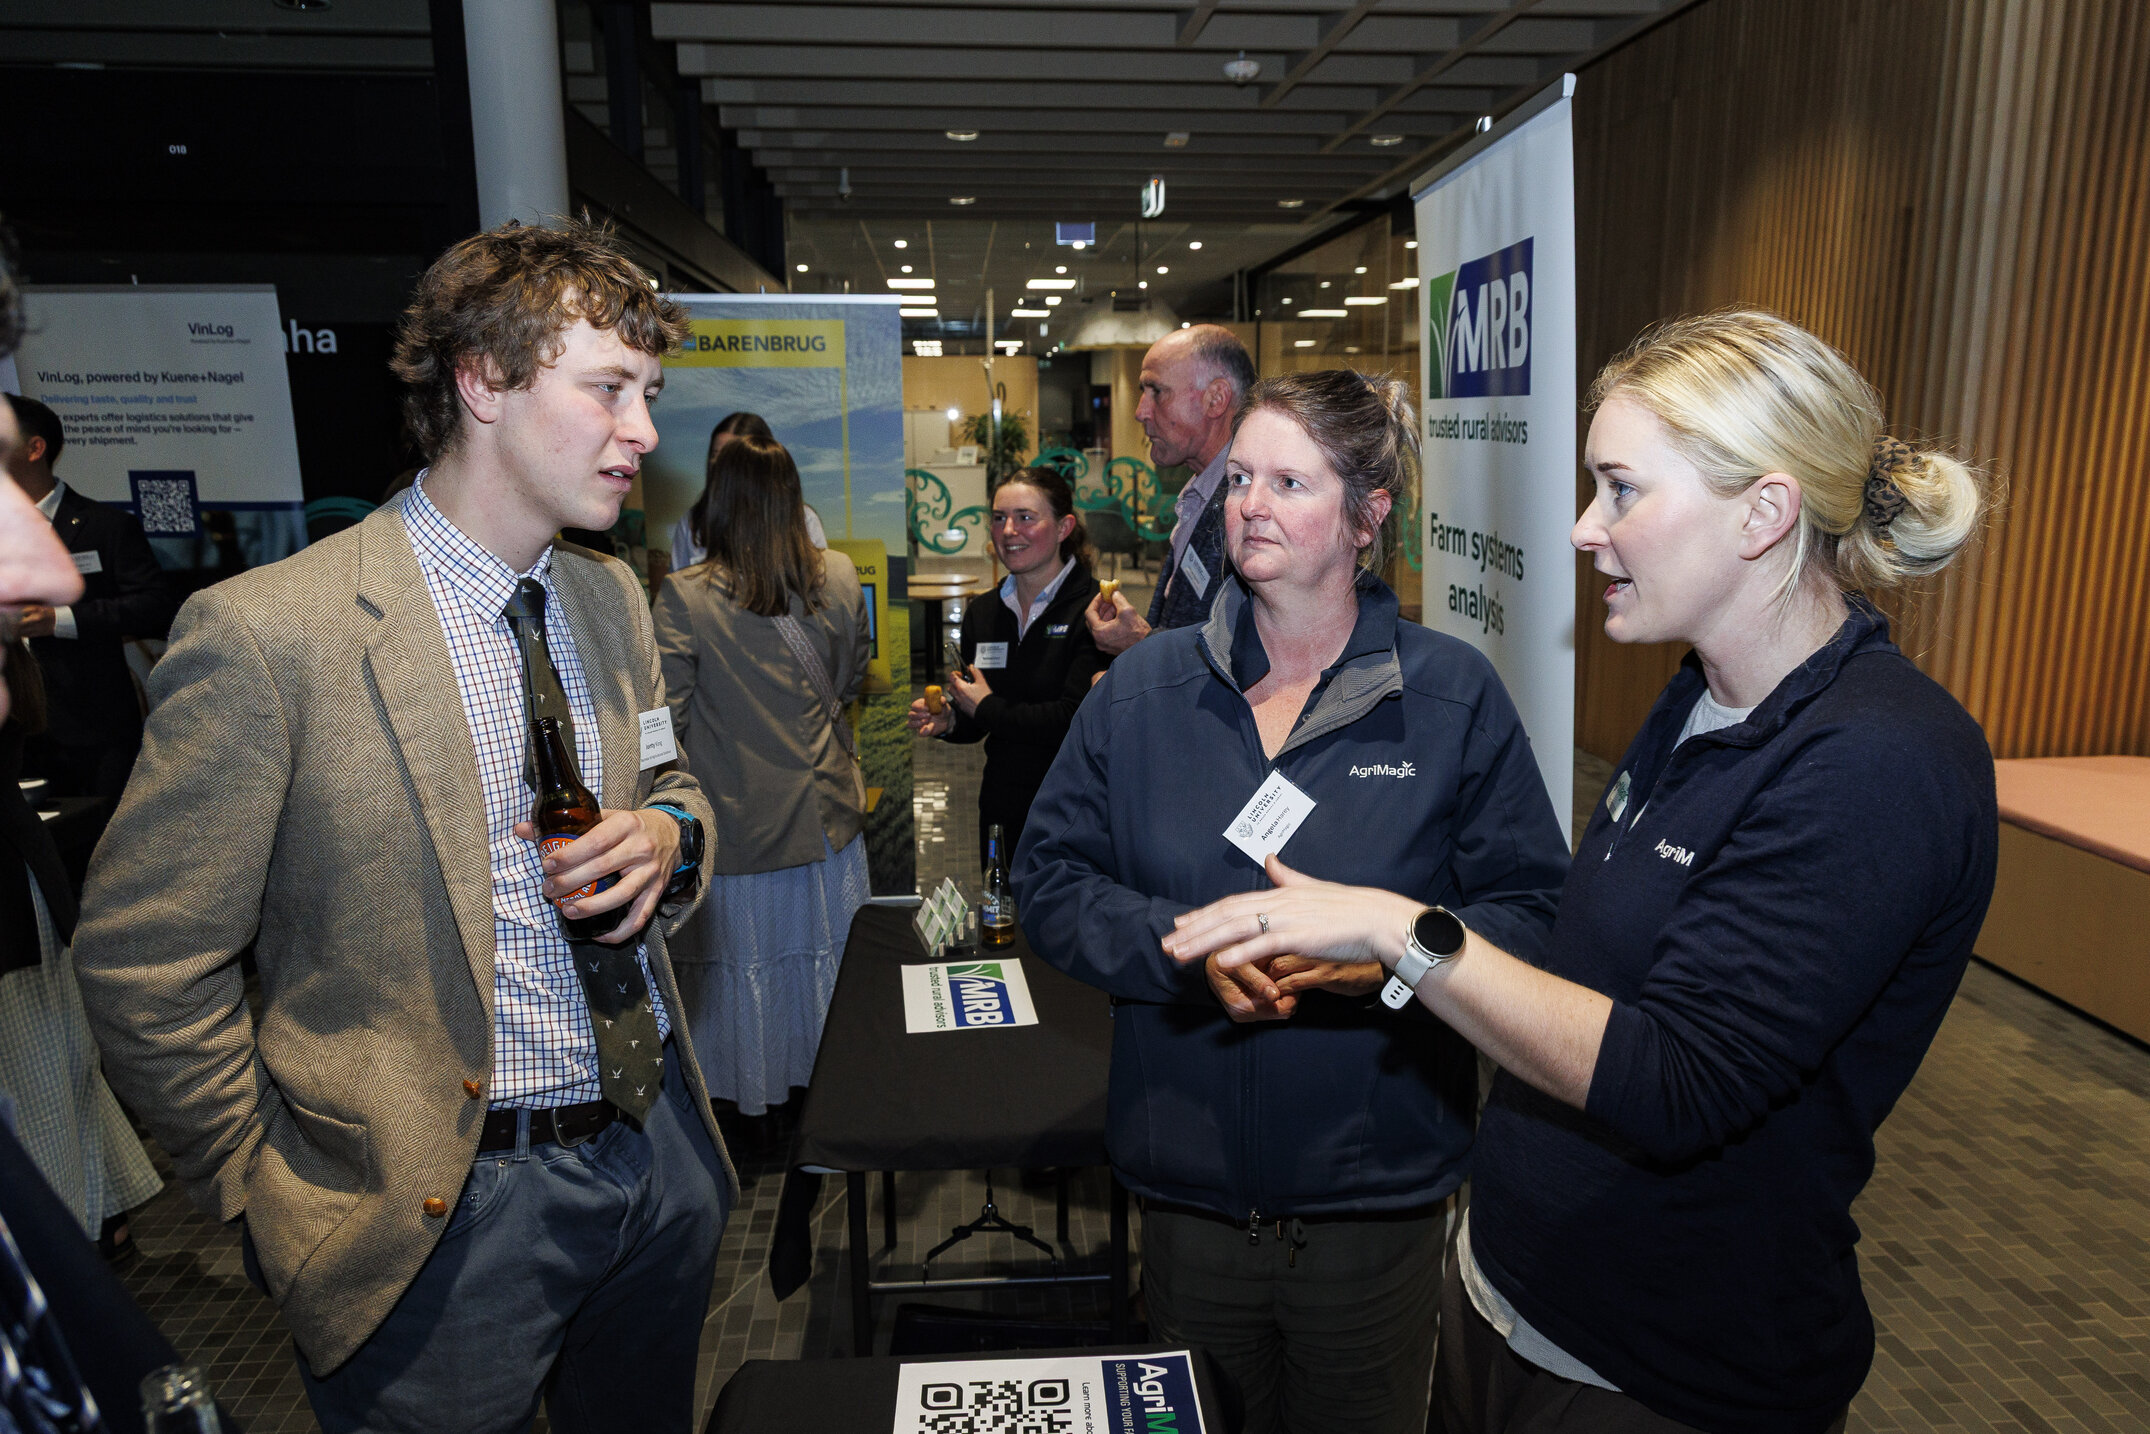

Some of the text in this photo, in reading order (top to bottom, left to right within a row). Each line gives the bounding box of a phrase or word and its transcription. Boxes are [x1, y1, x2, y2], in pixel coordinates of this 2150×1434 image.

[188, 322, 234, 337] VinLog
[1458, 270, 1529, 373] MRB
[698, 335, 826, 352] BARENBRUG
[37, 371, 84, 385] VinLog,
[86, 371, 140, 385] powered
[143, 371, 158, 385] by
[40, 394, 89, 405] Delivering
[119, 394, 154, 405] quality
[156, 394, 174, 404] and
[175, 394, 197, 404] trust
[63, 413, 99, 423] experts
[101, 412, 124, 422] offer
[126, 412, 167, 423] logistics
[168, 412, 211, 422] solutions
[212, 413, 232, 422] that
[233, 413, 255, 424] give
[1429, 412, 1528, 445] trusted rural advisors
[64, 424, 80, 433] the
[82, 425, 112, 435] peace
[114, 424, 124, 433] of
[126, 424, 150, 433] mind
[183, 424, 217, 435] looking
[218, 424, 232, 433] for
[1430, 512, 1524, 581] Farm systems
[1448, 584, 1505, 636] analysis
[643, 720, 667, 731] UNIVERSITY
[1348, 760, 1417, 779] AgriMagic
[1247, 792, 1269, 820] LINCOLN
[1251, 785, 1281, 823] UNIVERSITY
[1261, 820, 1279, 841] Angela
[1654, 838, 1695, 867] AgriM
[929, 966, 948, 1029] trusted rural advisors
[960, 982, 1004, 1025] MRB
[1082, 1381, 1091, 1401] Learn
[1115, 1363, 1131, 1407] SUPPORTING
[1133, 1362, 1179, 1434] AgriM
[1083, 1402, 1093, 1420] more
[1121, 1407, 1134, 1428] YOUR
